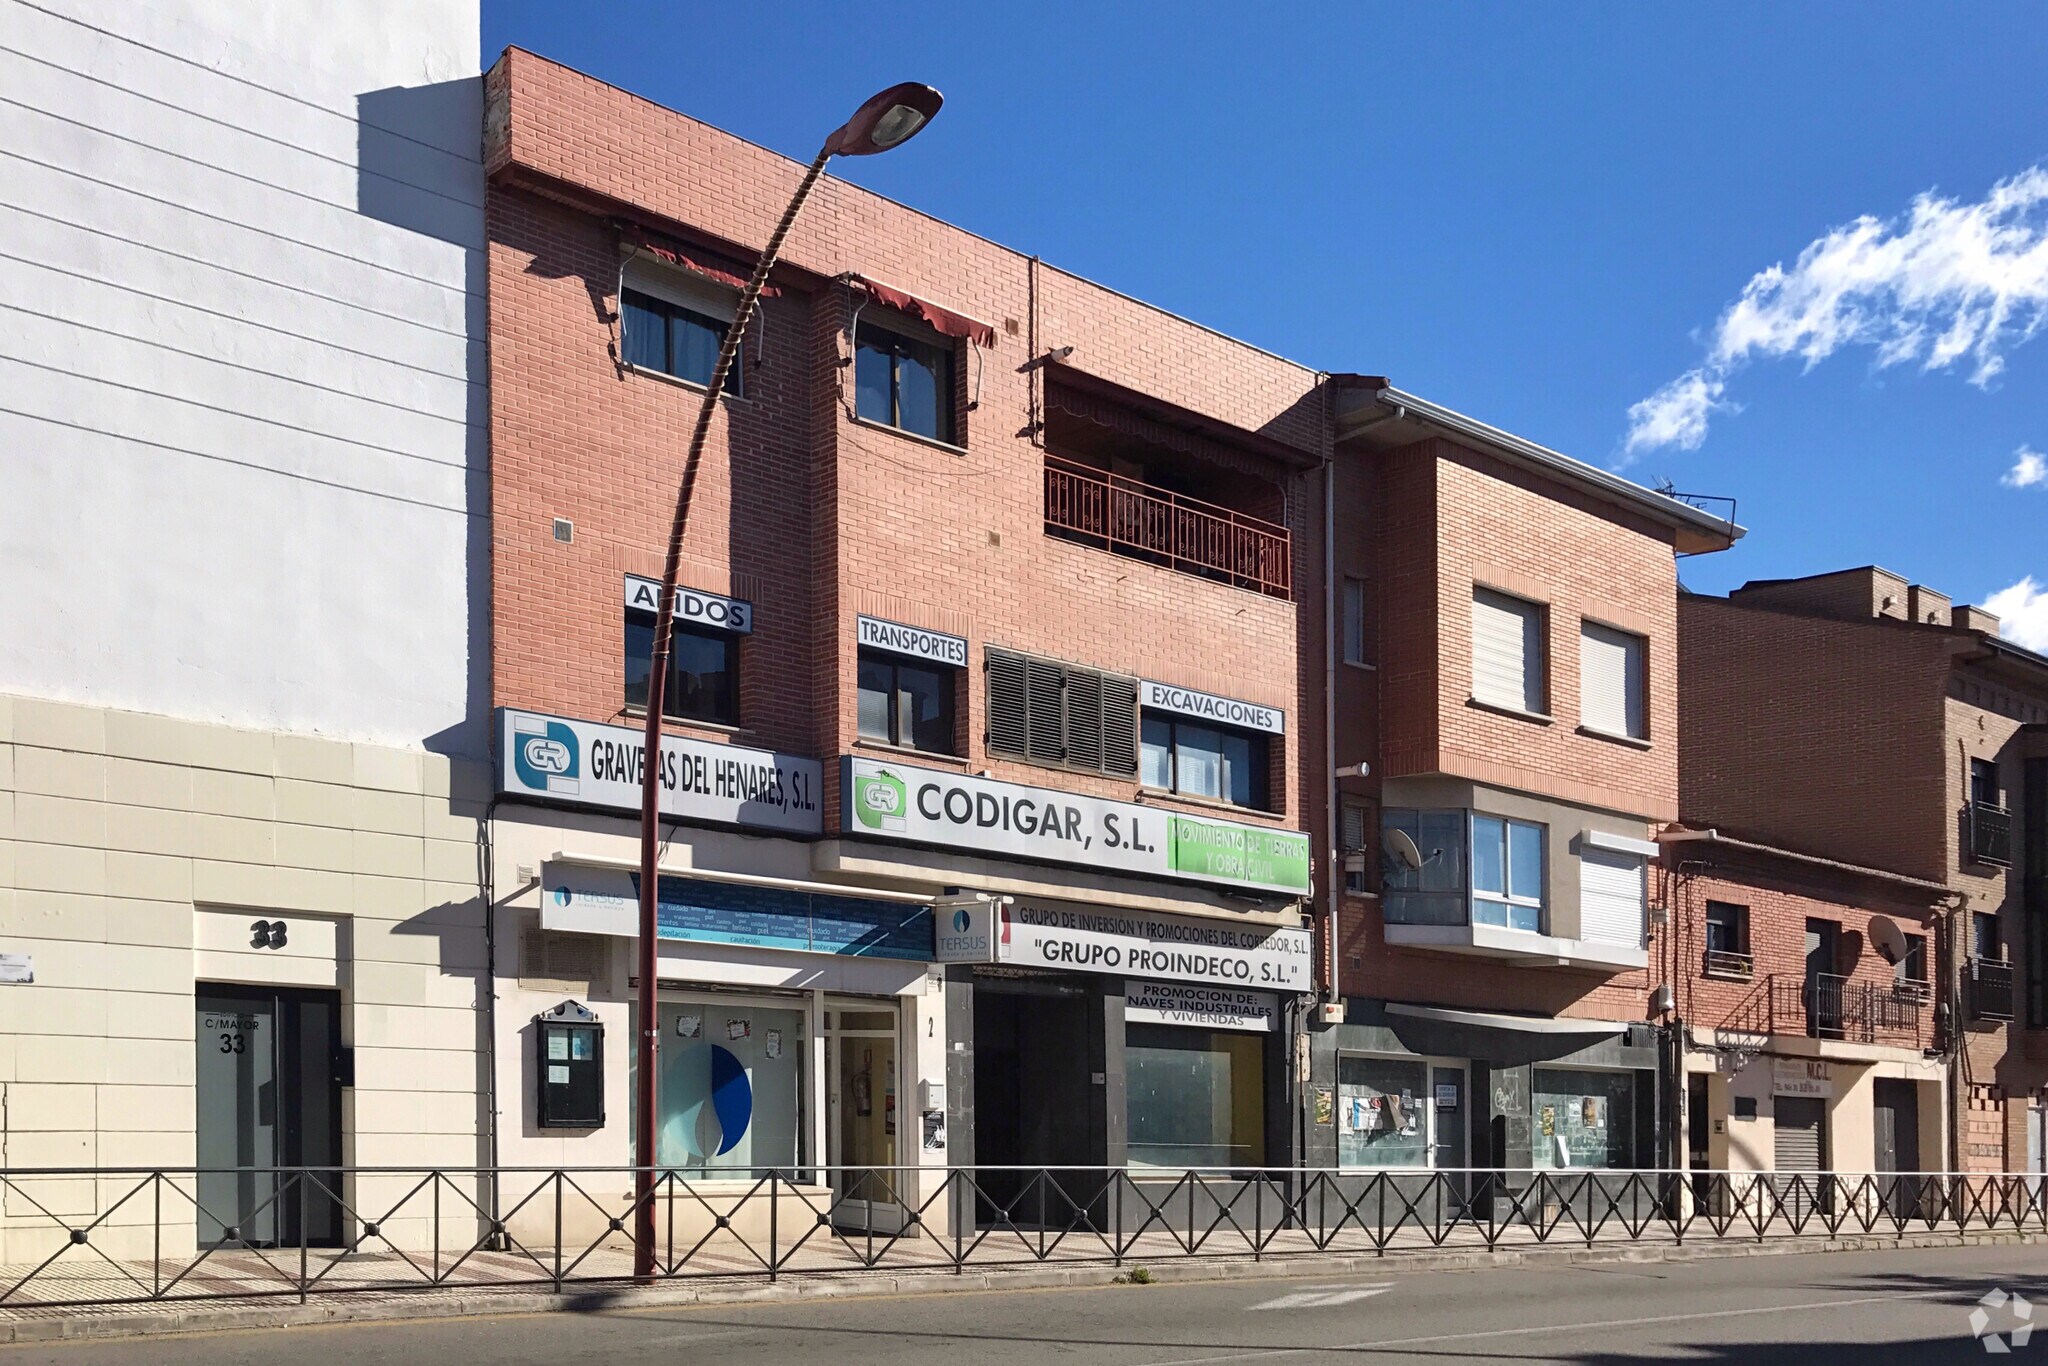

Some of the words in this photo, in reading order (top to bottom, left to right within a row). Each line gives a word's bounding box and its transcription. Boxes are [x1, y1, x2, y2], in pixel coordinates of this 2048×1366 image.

[633, 585, 745, 627] AIDOS
[861, 620, 964, 662] TRANSPORTES
[1152, 686, 1273, 728] EXCAVACIONES
[591, 738, 677, 791] GRAVEAS
[682, 753, 711, 795] DEL
[715, 758, 788, 815] HENARES,
[792, 770, 816, 812] S.L.
[917, 783, 1092, 851] CODIGAR,
[1104, 812, 1155, 853] S.L.
[1171, 822, 1244, 852] MOVIMIENTO
[1247, 834, 1261, 853] DE
[1264, 838, 1306, 861] TIERRAS
[1206, 853, 1213, 870] Y
[1215, 854, 1244, 876] OBRA
[1247, 859, 1275, 880] CIVIL
[575, 889, 624, 906] TERSUS
[704, 914, 715, 922] piel
[732, 924, 752, 932] belleza
[249, 919, 288, 950] 33
[757, 927, 769, 935] piel
[1020, 907, 1059, 926] GRUPO
[1062, 912, 1076, 929] DE
[1079, 914, 1135, 935] INVERSIÓN
[1137, 921, 1144, 935] Y
[1146, 921, 1219, 945] PROMOCIONES
[1221, 931, 1238, 947] DEL
[1240, 933, 1293, 955] CORREDOR,
[1294, 939, 1309, 954] S.L.
[939, 936, 987, 951] TERSUS
[1035, 938, 1121, 967] "GRUPO
[1128, 948, 1255, 984] PROINDECO,
[1261, 962, 1298, 984] S.L."
[1128, 995, 1175, 1009] NAVES
[1179, 1000, 1272, 1017] INDUSTRIALES
[1143, 985, 1232, 1002] PROMOCION
[1236, 994, 1258, 1005] DE:
[205, 1018, 260, 1031] C/MAYOR
[928, 1016, 934, 1038] 2
[1159, 1010, 1168, 1019] Y
[1171, 1011, 1244, 1026] VIVIENDAS
[220, 1033, 246, 1054] 33
